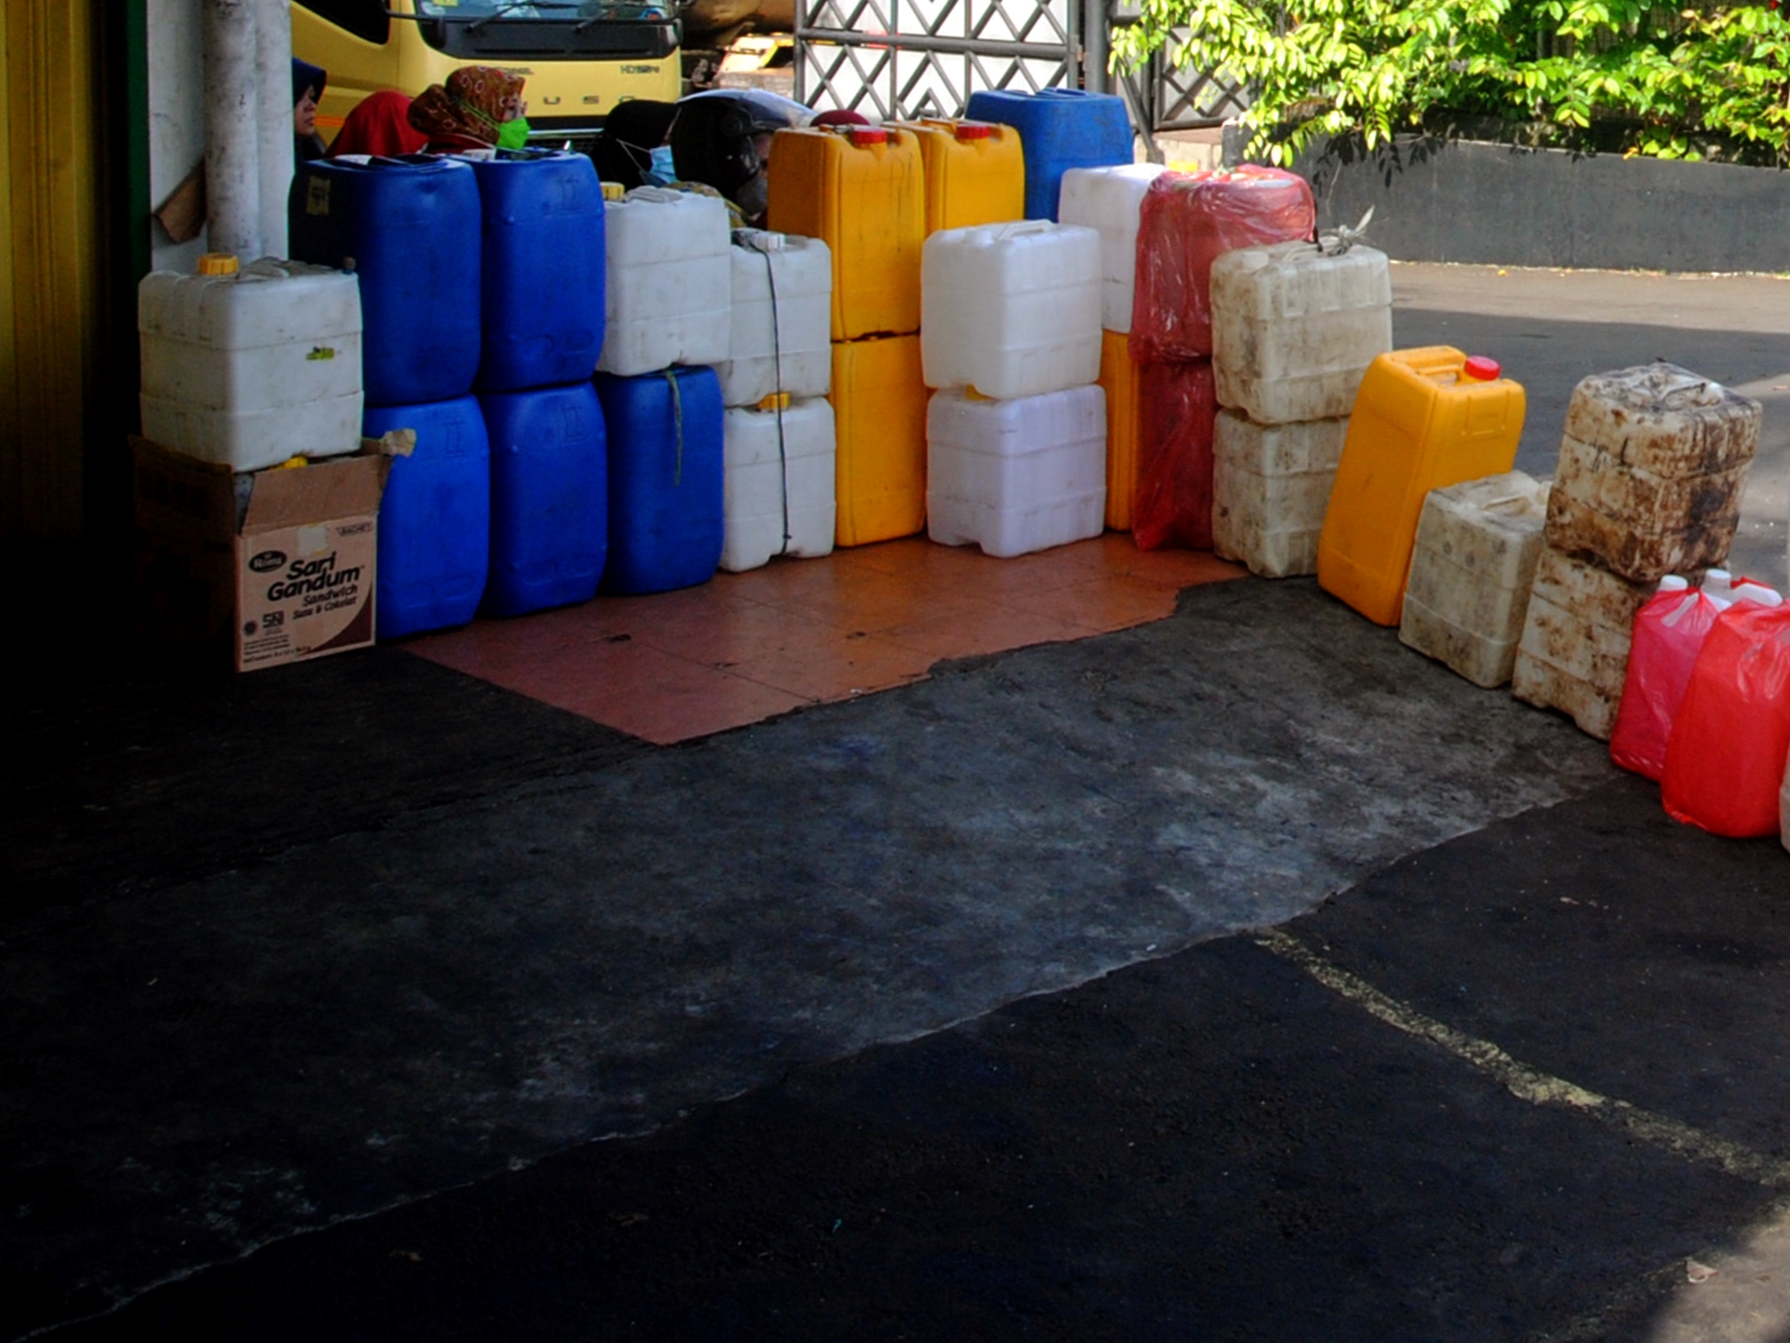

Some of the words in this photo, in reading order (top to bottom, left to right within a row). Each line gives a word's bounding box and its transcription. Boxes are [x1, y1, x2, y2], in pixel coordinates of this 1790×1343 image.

[286, 551, 337, 580] Sari
[267, 566, 361, 602] Gandum
[303, 584, 358, 607] Sandwich
